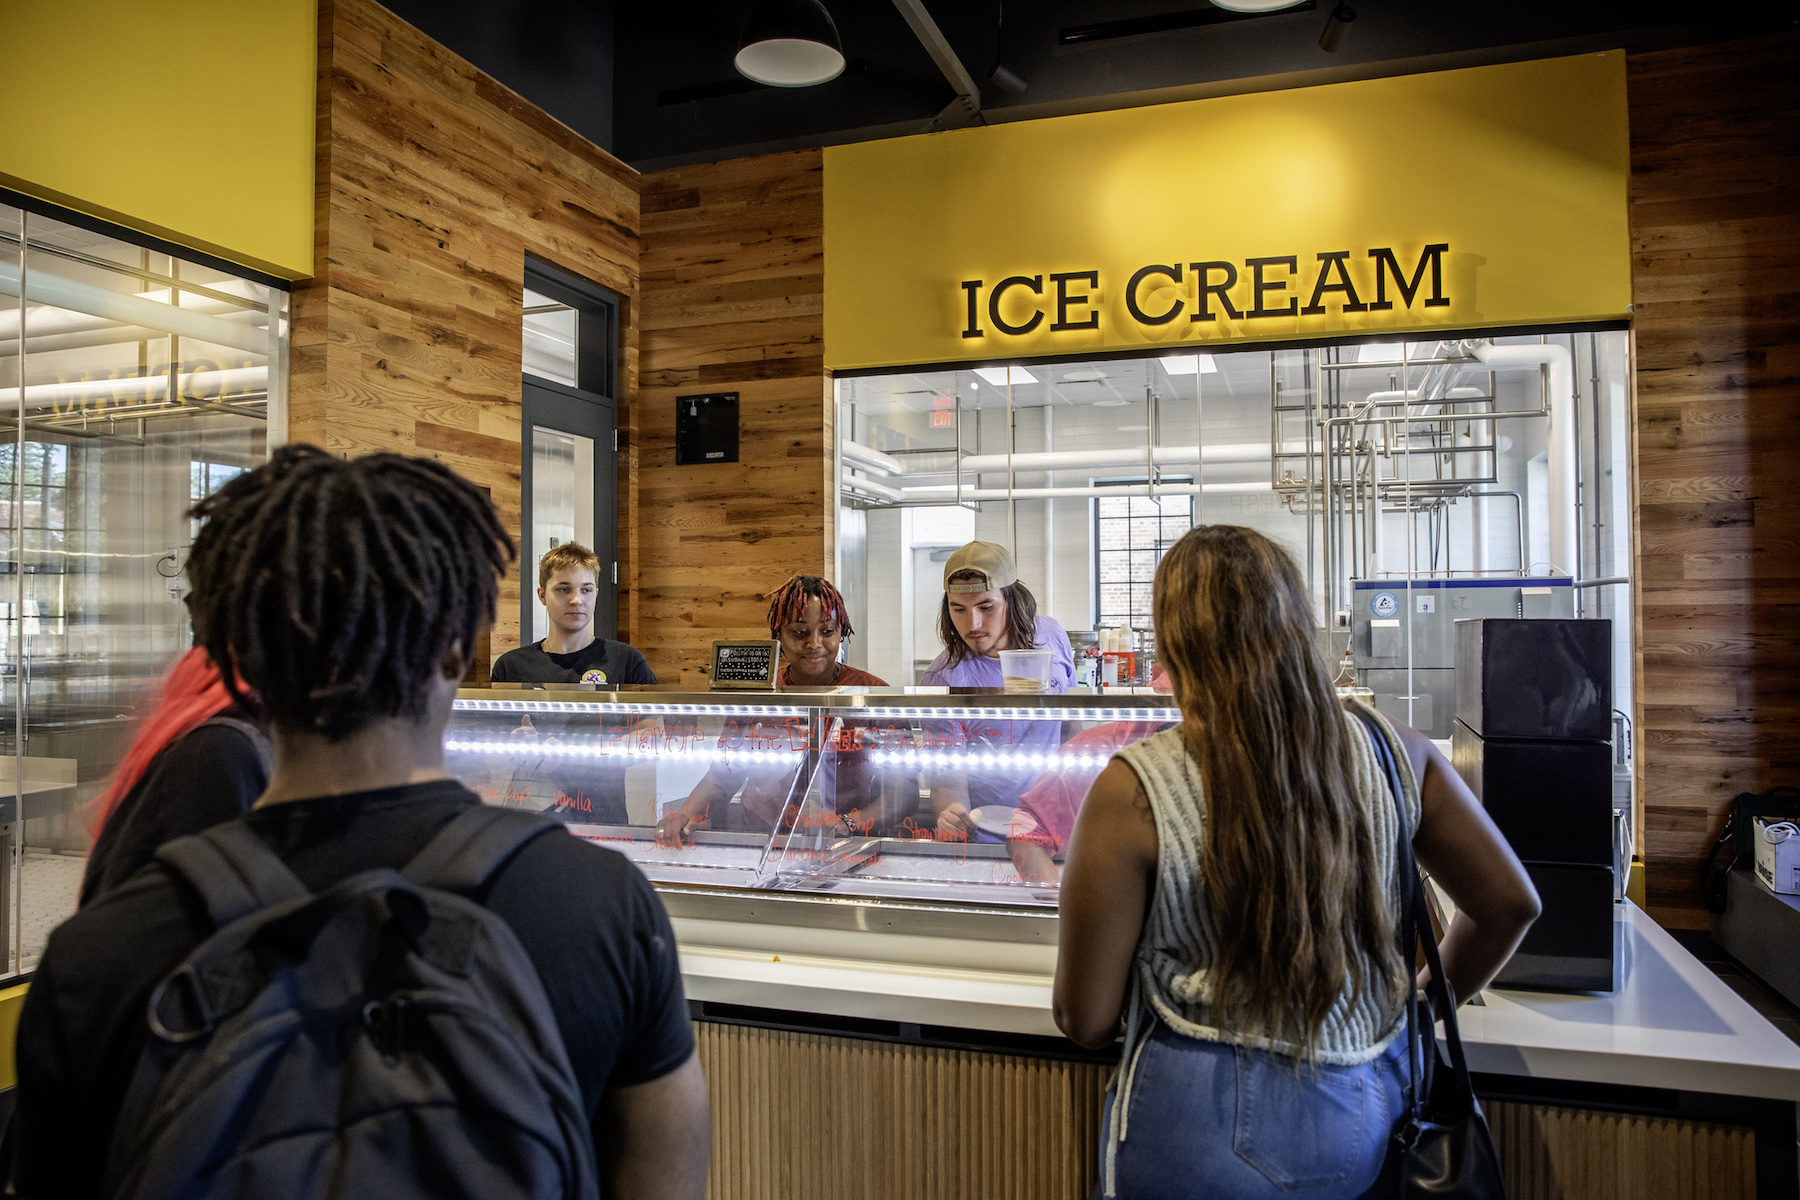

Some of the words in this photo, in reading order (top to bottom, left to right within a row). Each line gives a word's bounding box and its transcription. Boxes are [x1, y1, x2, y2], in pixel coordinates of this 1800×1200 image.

[961, 270, 1099, 338] ICE
[1125, 243, 1451, 327] CREAM
[933, 412, 952, 427] EXIT
[600, 711, 705, 756] Flavor
[717, 721, 743, 766] of
[745, 723, 782, 750] the
[883, 724, 953, 752] Chocolate
[553, 787, 592, 813] Vanilla
[784, 804, 845, 829] Chocolate
[848, 807, 875, 837] Chip
[766, 834, 828, 881] Blueberry
[832, 840, 887, 868] Cheesecake
[898, 816, 967, 866] Strawberry
[1002, 823, 1065, 868] Tigerbite
[991, 861, 1038, 886] Cookies
